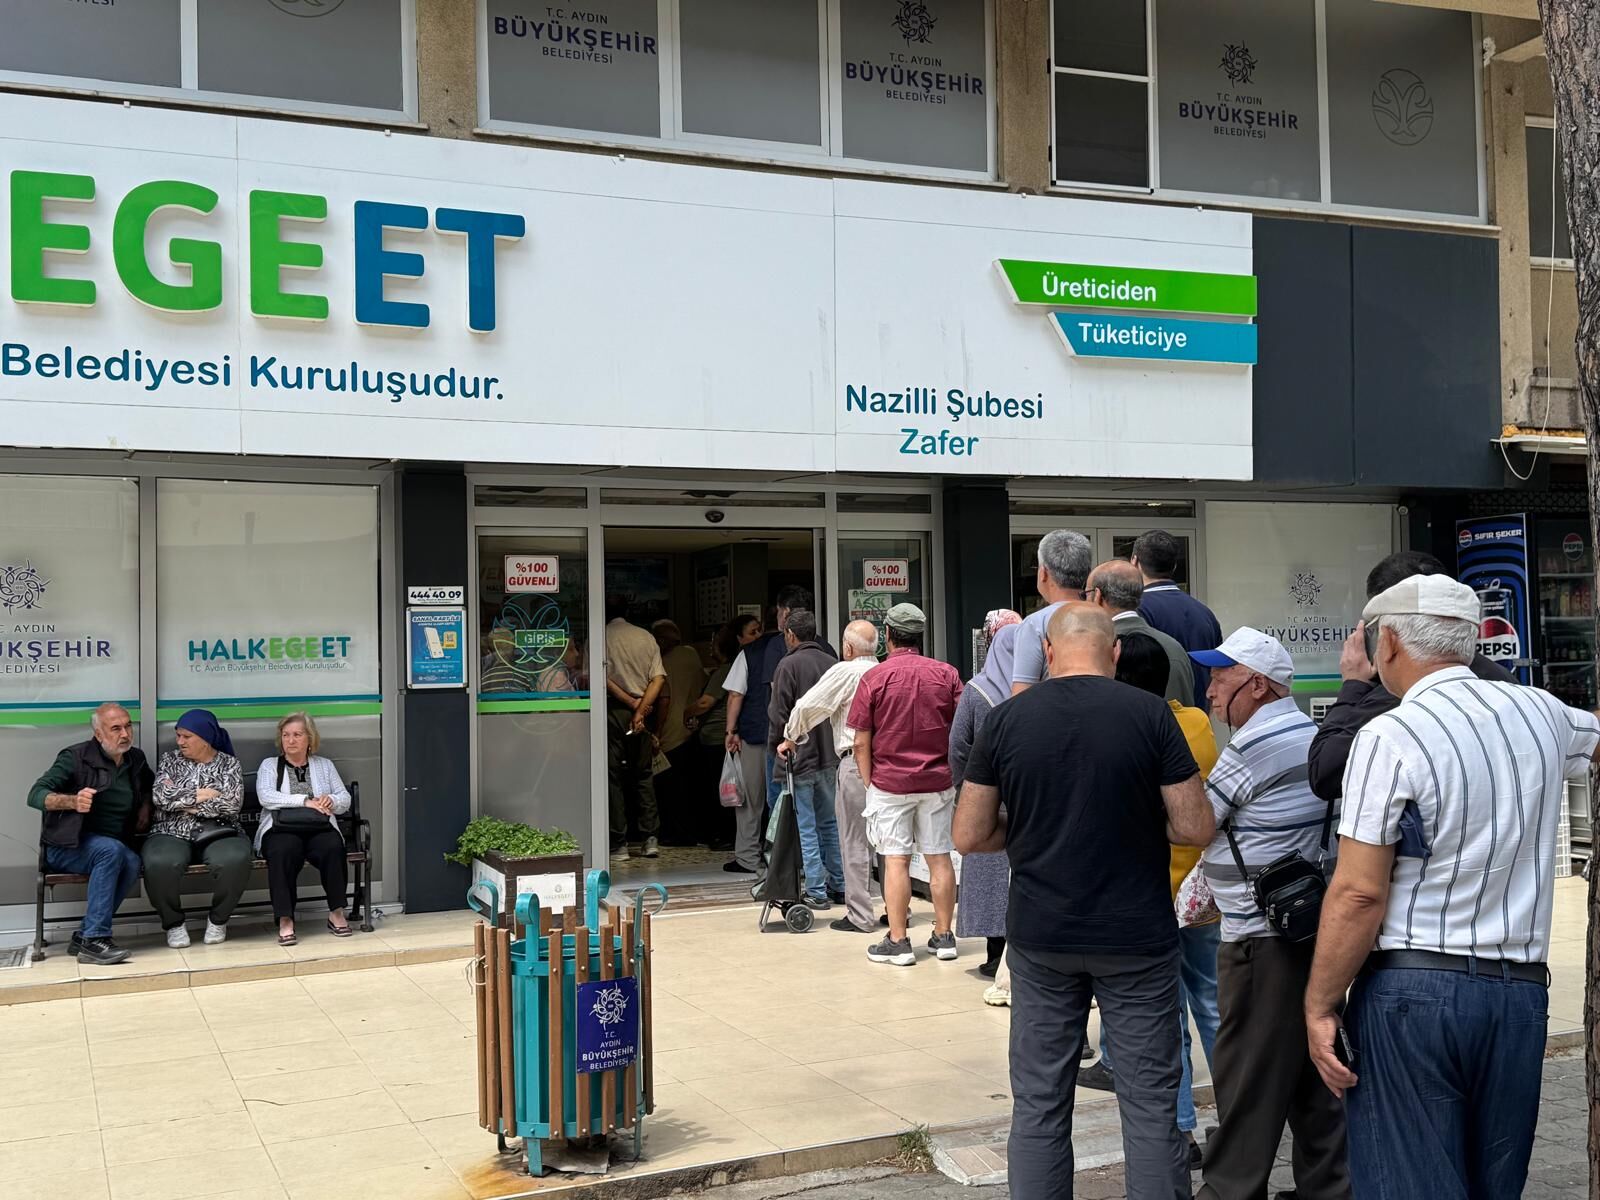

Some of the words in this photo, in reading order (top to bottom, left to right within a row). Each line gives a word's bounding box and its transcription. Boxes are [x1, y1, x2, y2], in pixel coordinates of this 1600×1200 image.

[546, 7, 568, 19] T.C.
[571, 11, 608, 24] AYDIN
[494, 15, 657, 55] BÜYÜKŞEHİR
[542, 46, 613, 64] BELEDİYESİ
[889, 52, 908, 63] T.C.
[911, 55, 942, 67] AYDIN
[845, 60, 984, 95] BÜYÜKŞEHİR
[886, 89, 946, 105] BELEDİYESİ
[1235, 95, 1262, 105] AYDIN
[1179, 100, 1298, 130] BÜYÜKŞEHİR
[1214, 126, 1266, 139] BELEDİYESİ
[1042, 271, 1157, 302] Üreticiden
[1078, 322, 1187, 351] Tüketiciye
[2, 343, 231, 391] Belediyesi
[250, 355, 504, 403] Kuruluşudur.
[845, 384, 937, 416] Nazilli
[946, 388, 1044, 422] Şubesi
[899, 428, 980, 457] Zafer
[1474, 532, 1494, 540] SIFIR
[1495, 529, 1522, 540] ŞEKER
[516, 562, 548, 573] %100
[872, 564, 900, 574] %100
[508, 574, 556, 586] GÜVENLİ
[866, 575, 906, 587] GÜVENLİ
[410, 591, 430, 599] 444
[432, 591, 446, 599] 40
[448, 590, 462, 599] 09
[14, 624, 55, 633] AYDIN
[0, 635, 111, 663] KŞEHİR
[188, 636, 352, 661] HALKEGEET
[600, 1039, 621, 1048] AYDIN
[582, 1045, 634, 1062] BÜYÜKŞEHİR
